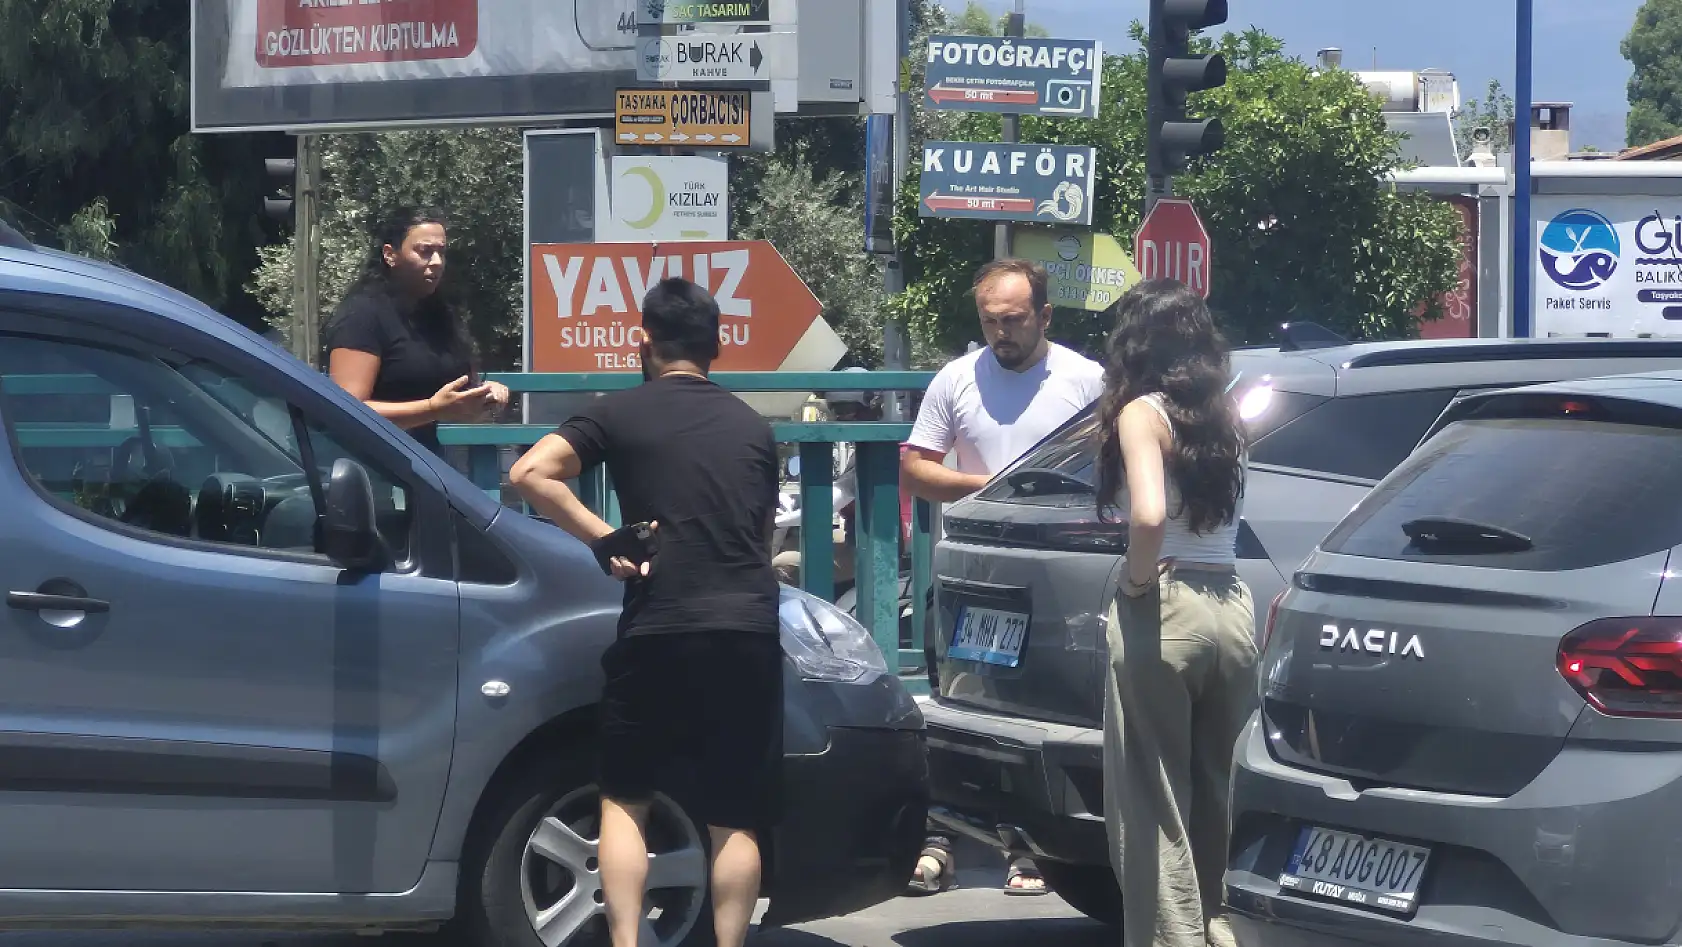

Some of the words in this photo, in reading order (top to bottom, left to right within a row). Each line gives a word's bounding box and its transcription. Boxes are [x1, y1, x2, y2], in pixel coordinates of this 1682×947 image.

[696, 3, 751, 17] TASARIM
[266, 23, 366, 56] GÖZLÜKTEN
[370, 22, 459, 51] KURTULMA
[677, 42, 743, 63] BURAK
[927, 40, 1093, 75] FOTOĞRAFÇI
[692, 68, 728, 77] KAHVE
[980, 91, 994, 100] mt
[619, 95, 667, 113] TAŞYAKA
[670, 94, 744, 132] ÇORBACISI
[923, 147, 1085, 178] KUAFÖR
[683, 180, 705, 190] TÜRK
[949, 184, 963, 192] The
[964, 184, 977, 193] Art
[978, 185, 995, 193] Hair
[996, 186, 1020, 194] Studio
[669, 192, 719, 207] KIZILAY
[967, 199, 979, 208] 50
[982, 199, 995, 208] mt
[1546, 297, 1576, 310] Paket
[1580, 297, 1611, 310] Servis
[560, 321, 642, 347] SÜRÜC
[1319, 624, 1425, 658] DACIA
[1312, 880, 1346, 898] KUTAY
